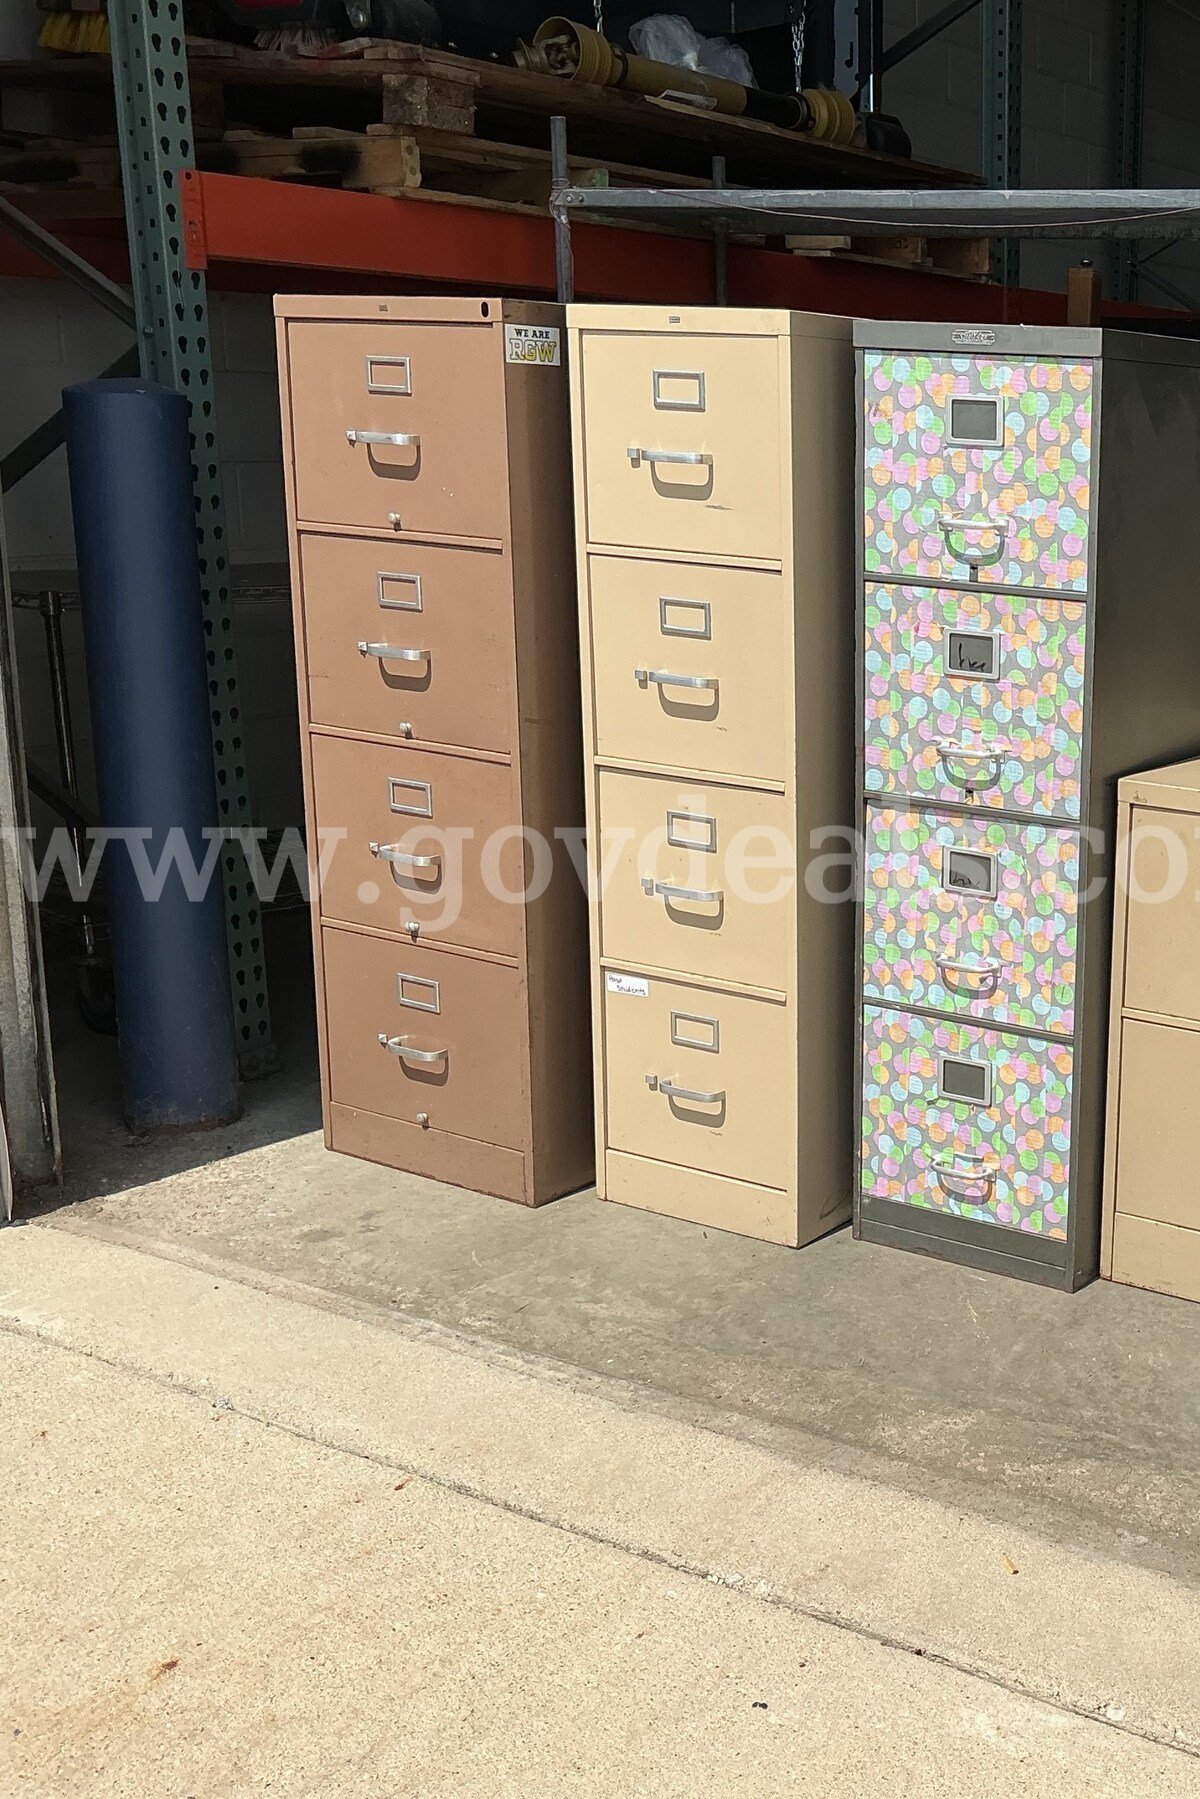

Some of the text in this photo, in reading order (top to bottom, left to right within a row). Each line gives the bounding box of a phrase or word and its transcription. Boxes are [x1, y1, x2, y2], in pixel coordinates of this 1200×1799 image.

[514, 329, 550, 339] WE ARE
[509, 338, 556, 362] RGW
